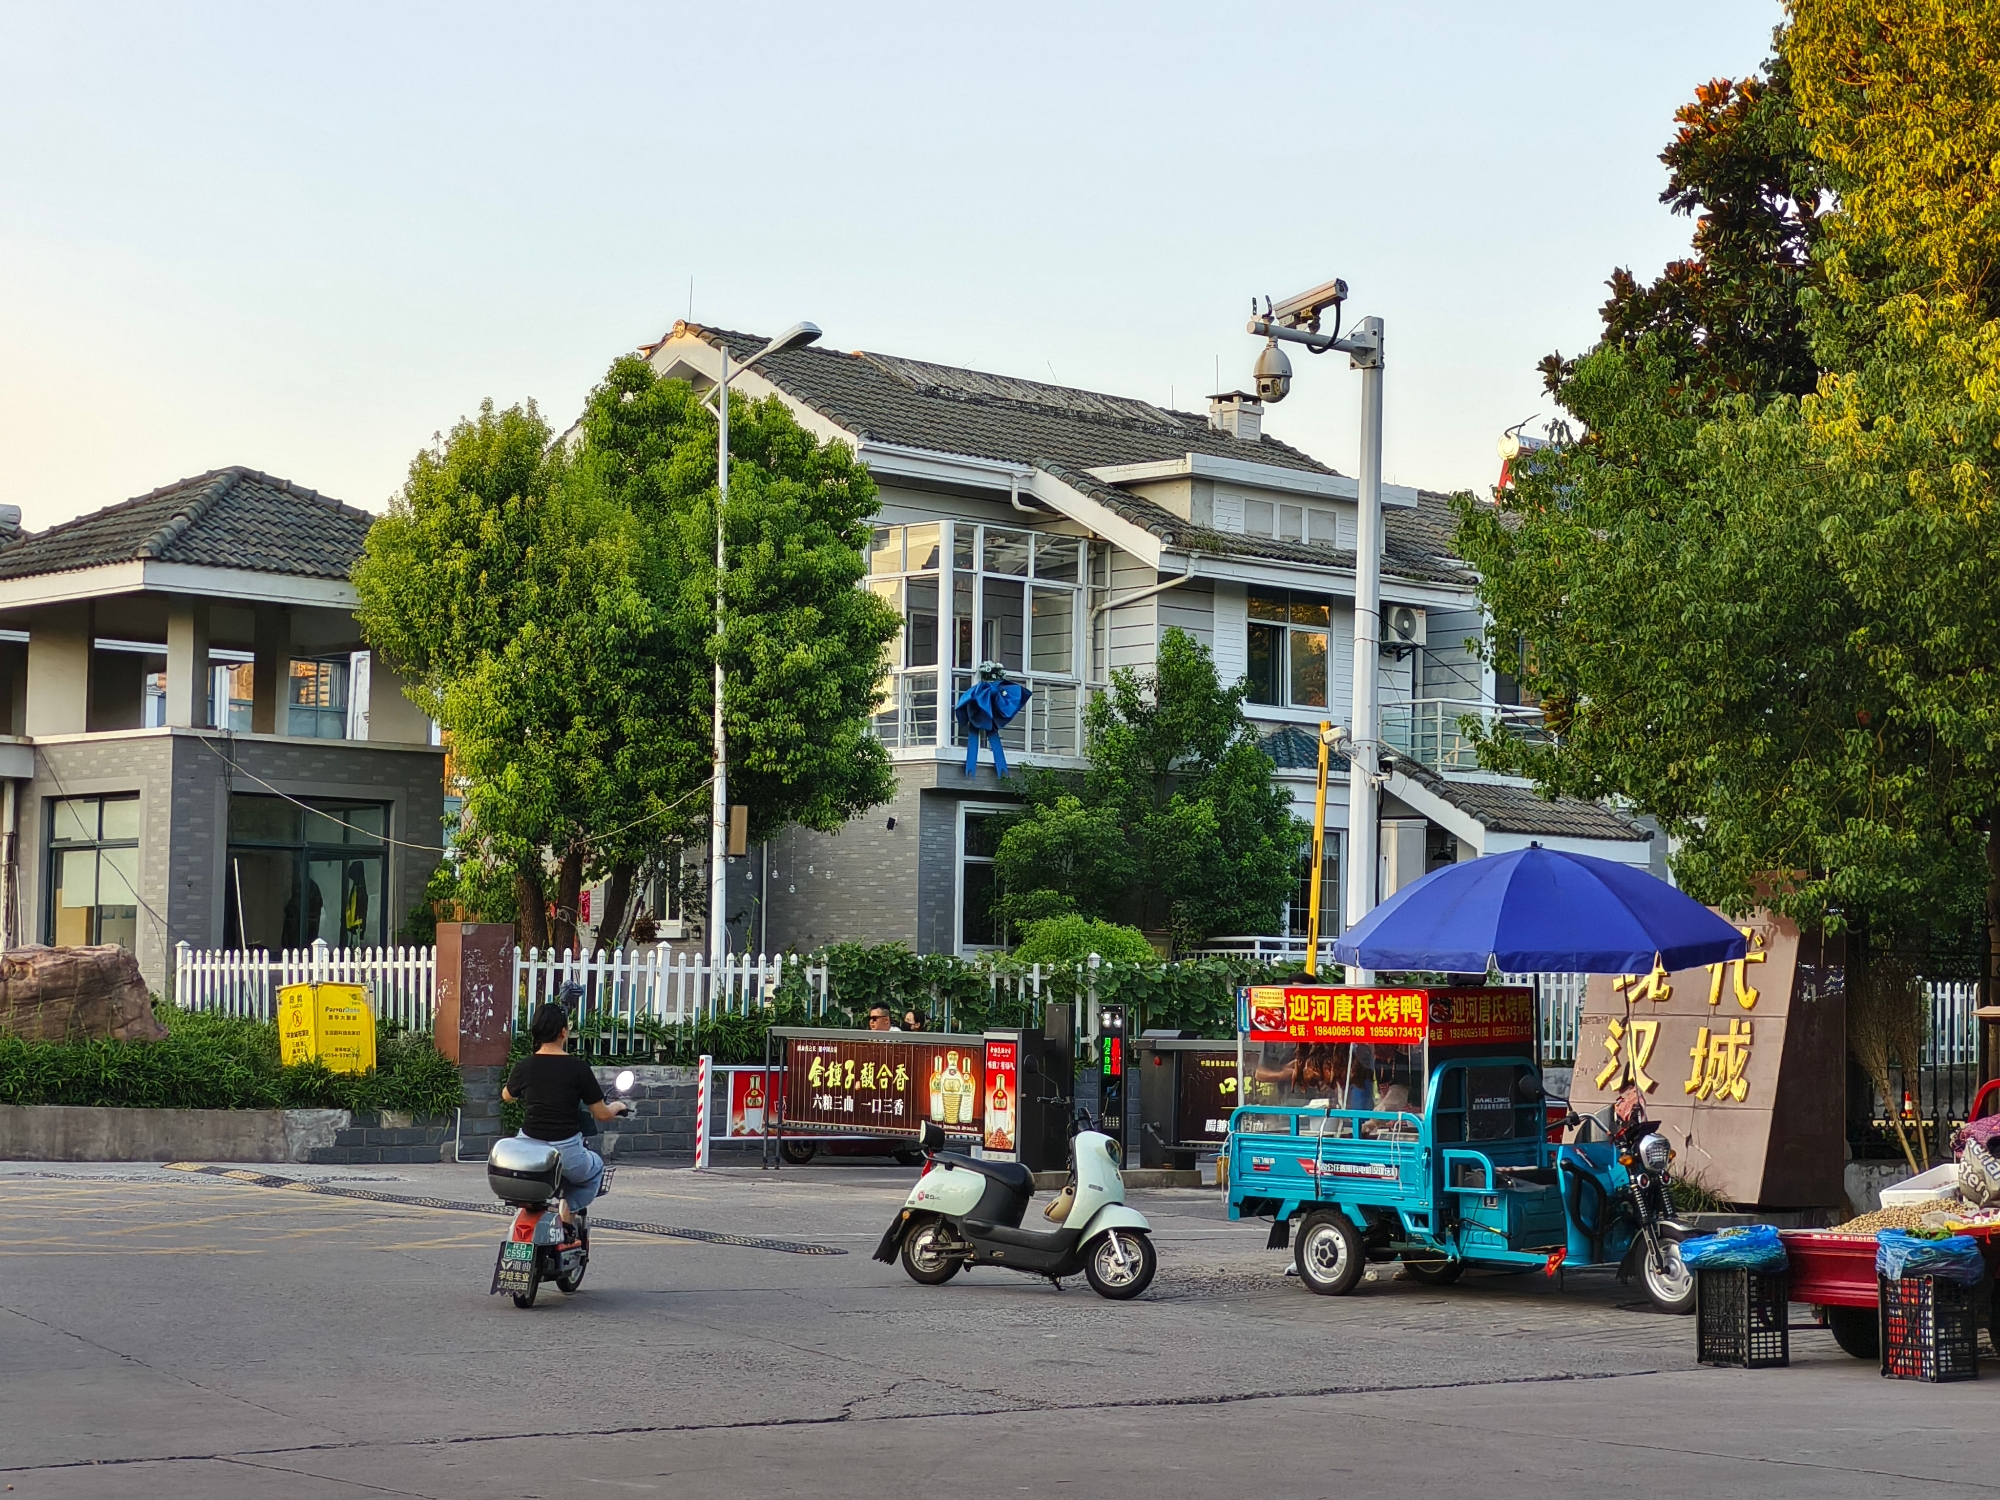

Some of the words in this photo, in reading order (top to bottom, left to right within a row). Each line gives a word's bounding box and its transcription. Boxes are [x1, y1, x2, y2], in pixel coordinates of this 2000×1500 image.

[1288, 993, 1424, 1023] 迎河唐氏烤鸭
[1452, 992, 1532, 1023] 迎河唐氏烤鸭
[1314, 1025, 1365, 1037] 19840095168
[1370, 1026, 1423, 1038] 19556173413
[1595, 1018, 1752, 1103] 汉城
[812, 1094, 854, 1113] 六粮三曲
[861, 1098, 904, 1116] 一口三香
